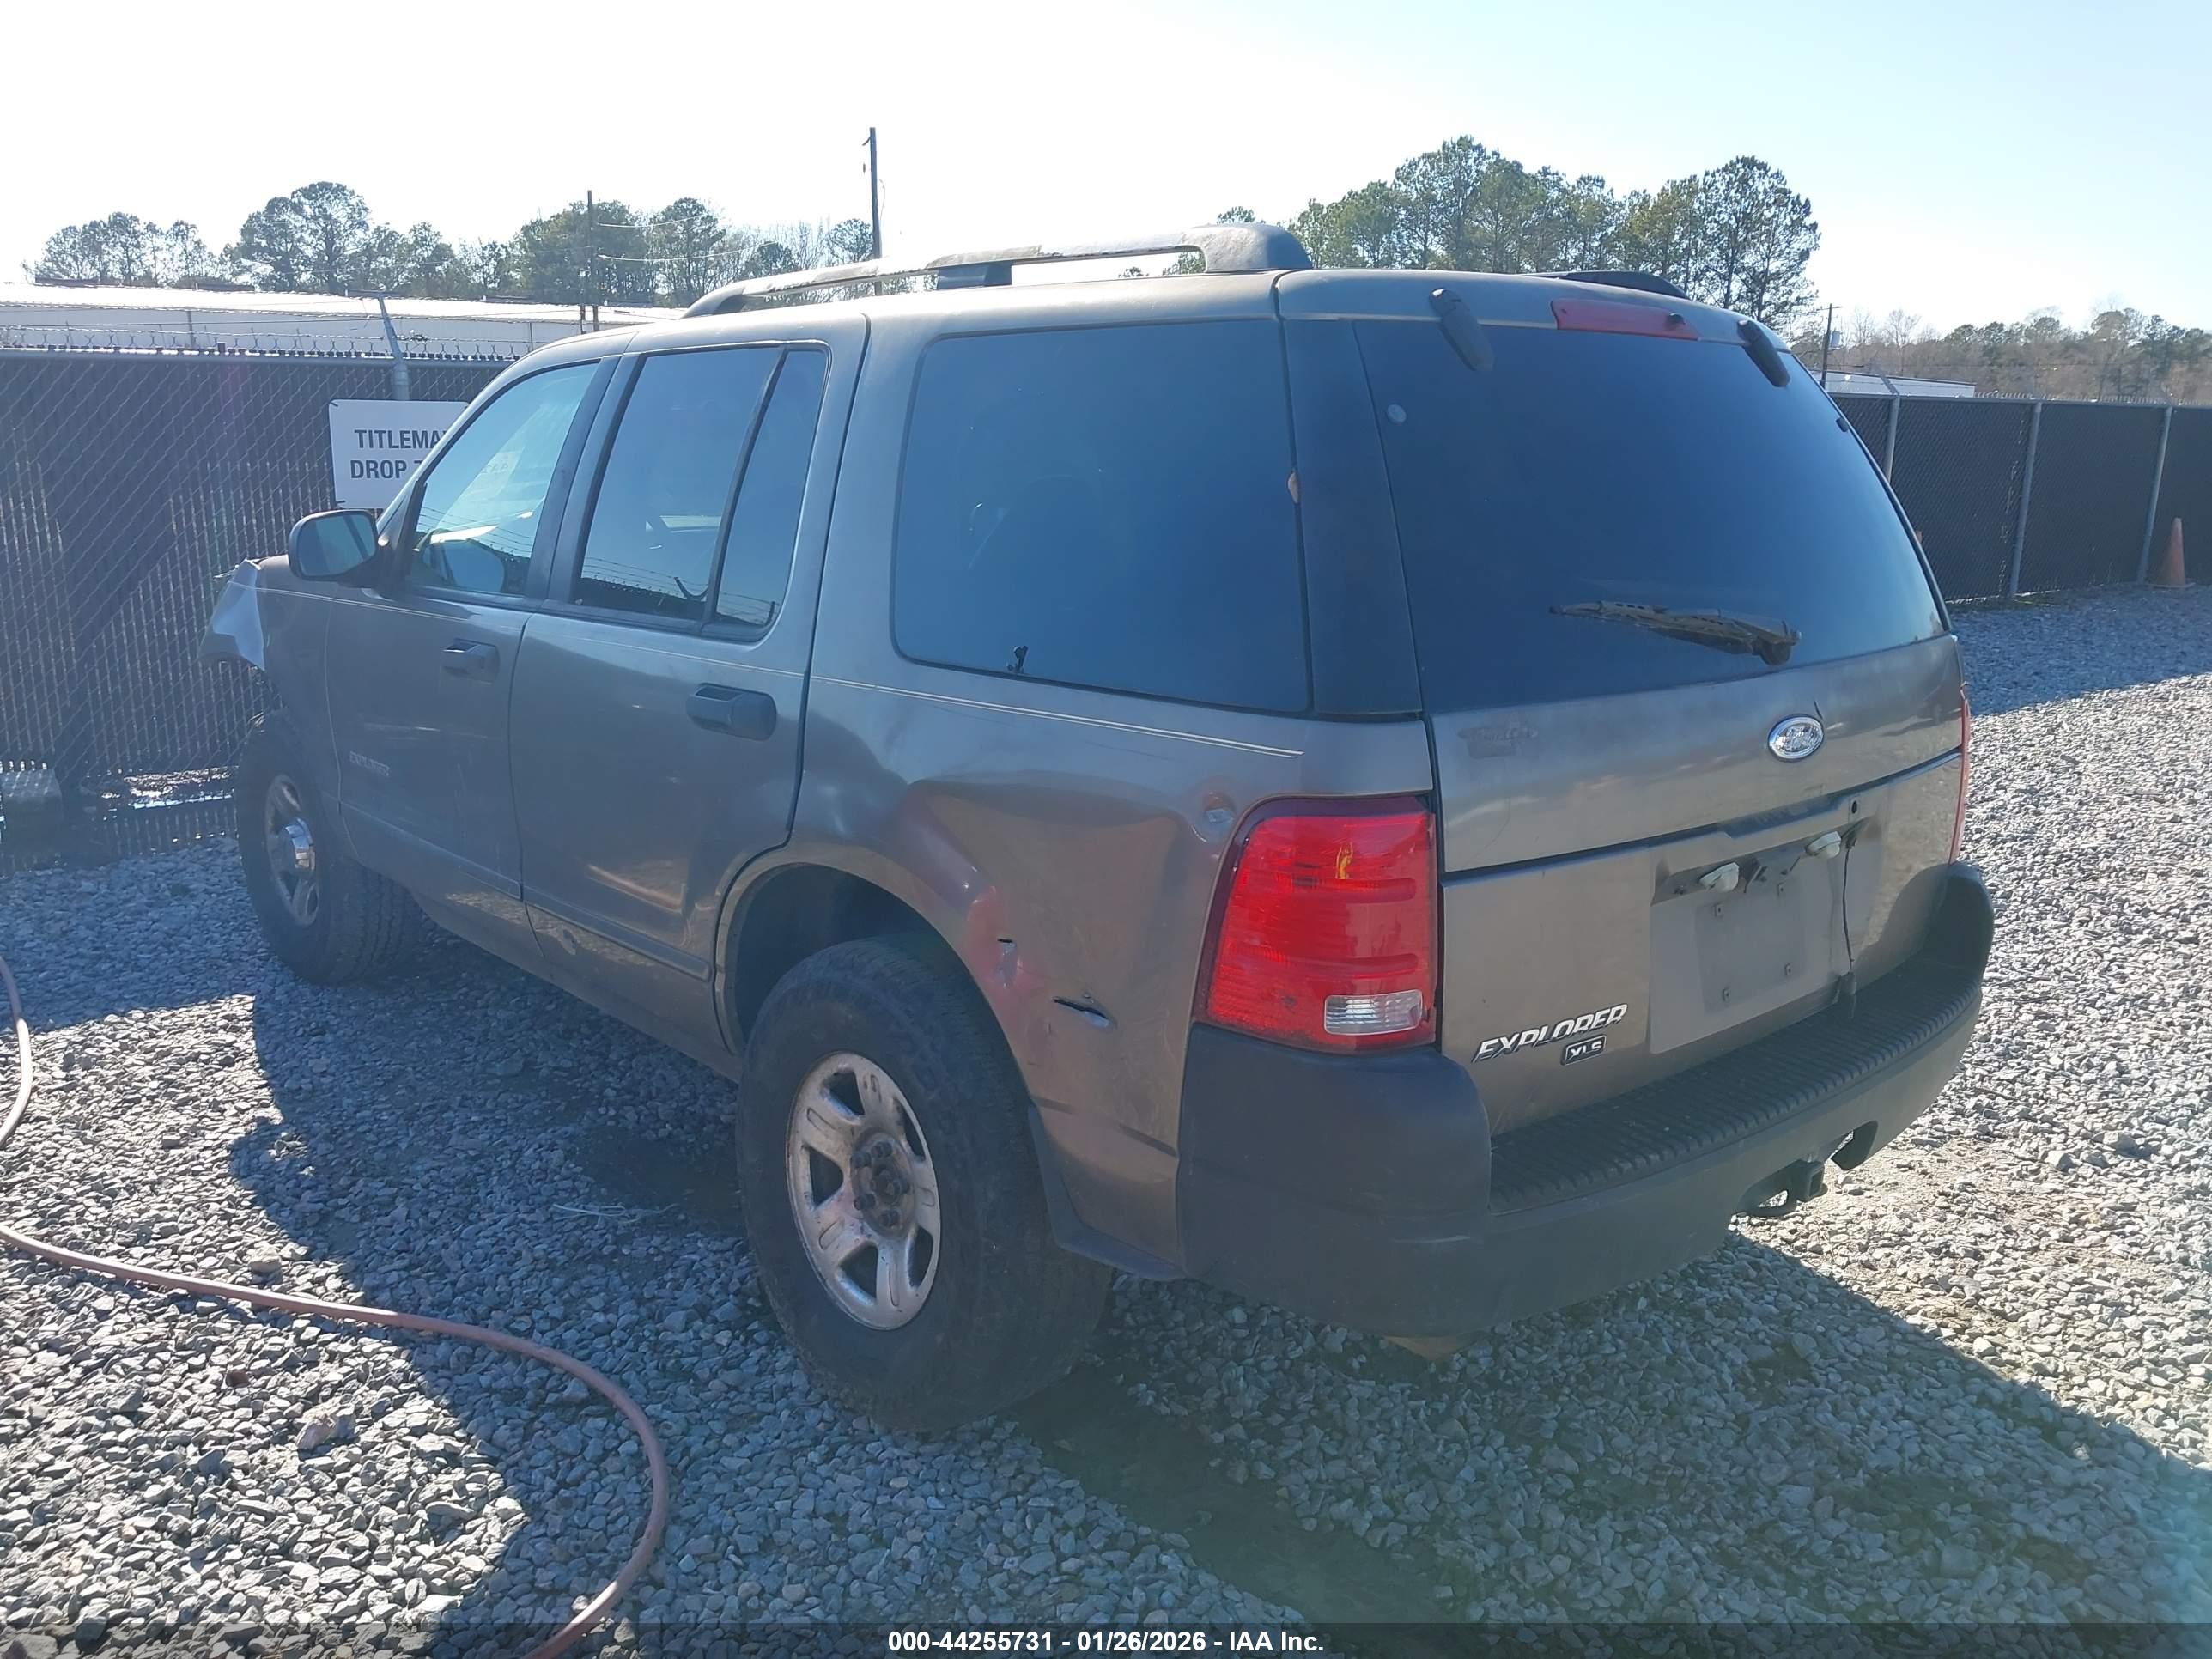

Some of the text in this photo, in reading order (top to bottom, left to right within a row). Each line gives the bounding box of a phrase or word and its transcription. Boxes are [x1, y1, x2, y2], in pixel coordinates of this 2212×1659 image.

[355, 429, 447, 449] TITLEMA
[350, 459, 408, 479] DROP
[1471, 1003, 1629, 1063] EXPLORER
[1565, 1040, 1604, 1060] XLS
